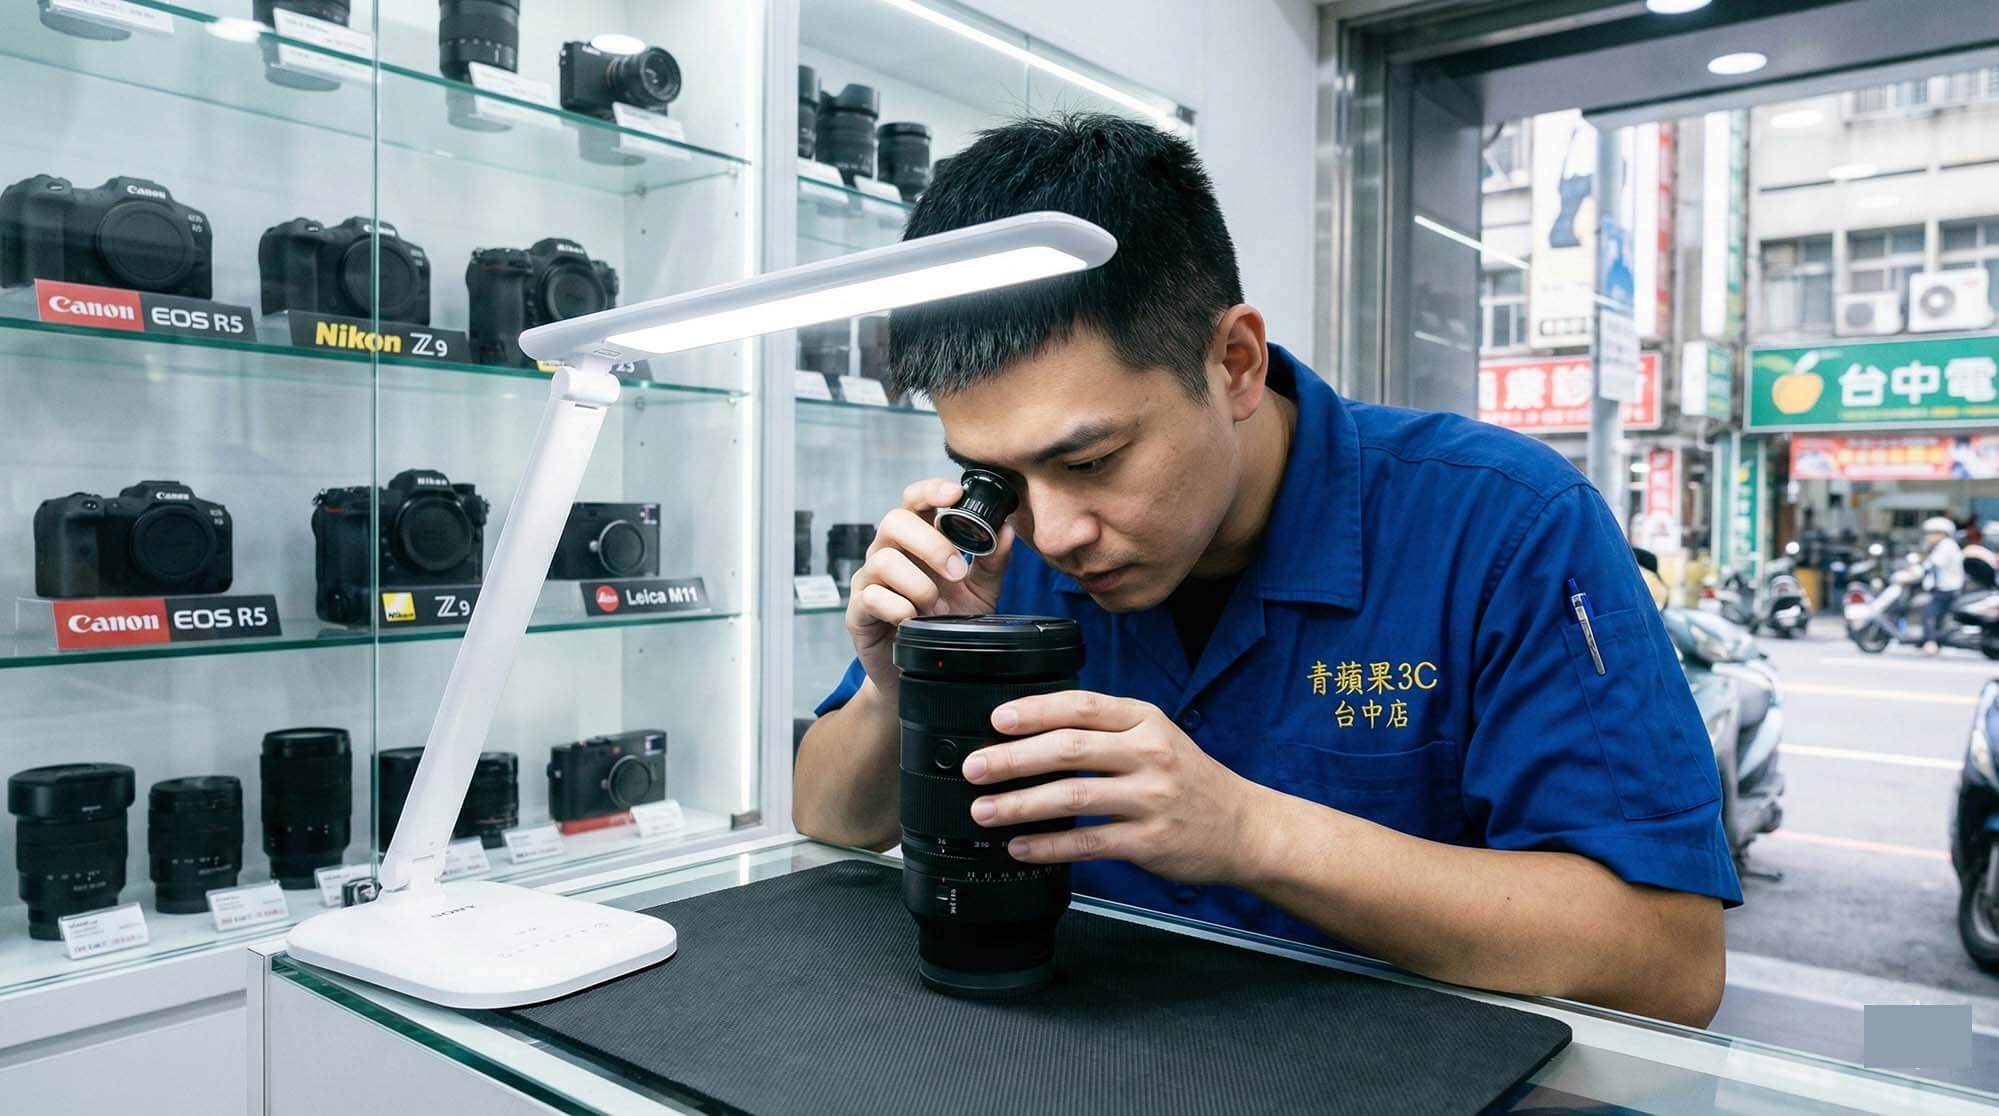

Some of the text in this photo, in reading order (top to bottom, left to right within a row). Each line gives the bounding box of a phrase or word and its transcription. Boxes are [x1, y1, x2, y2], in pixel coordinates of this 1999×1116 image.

[127, 185, 166, 199] Canon
[48, 295, 244, 334] Canon EOS R5
[315, 321, 448, 357] Nikon Z9
[417, 476, 448, 486] Nikon
[155, 491, 190, 501] Canon
[434, 595, 471, 617] Z9
[625, 588, 666, 606] Leica
[667, 586, 698, 605] M11
[67, 606, 268, 633] Canon EOS R5
[1306, 660, 1438, 695] 青蘋果3C
[1334, 698, 1409, 729] 台中店
